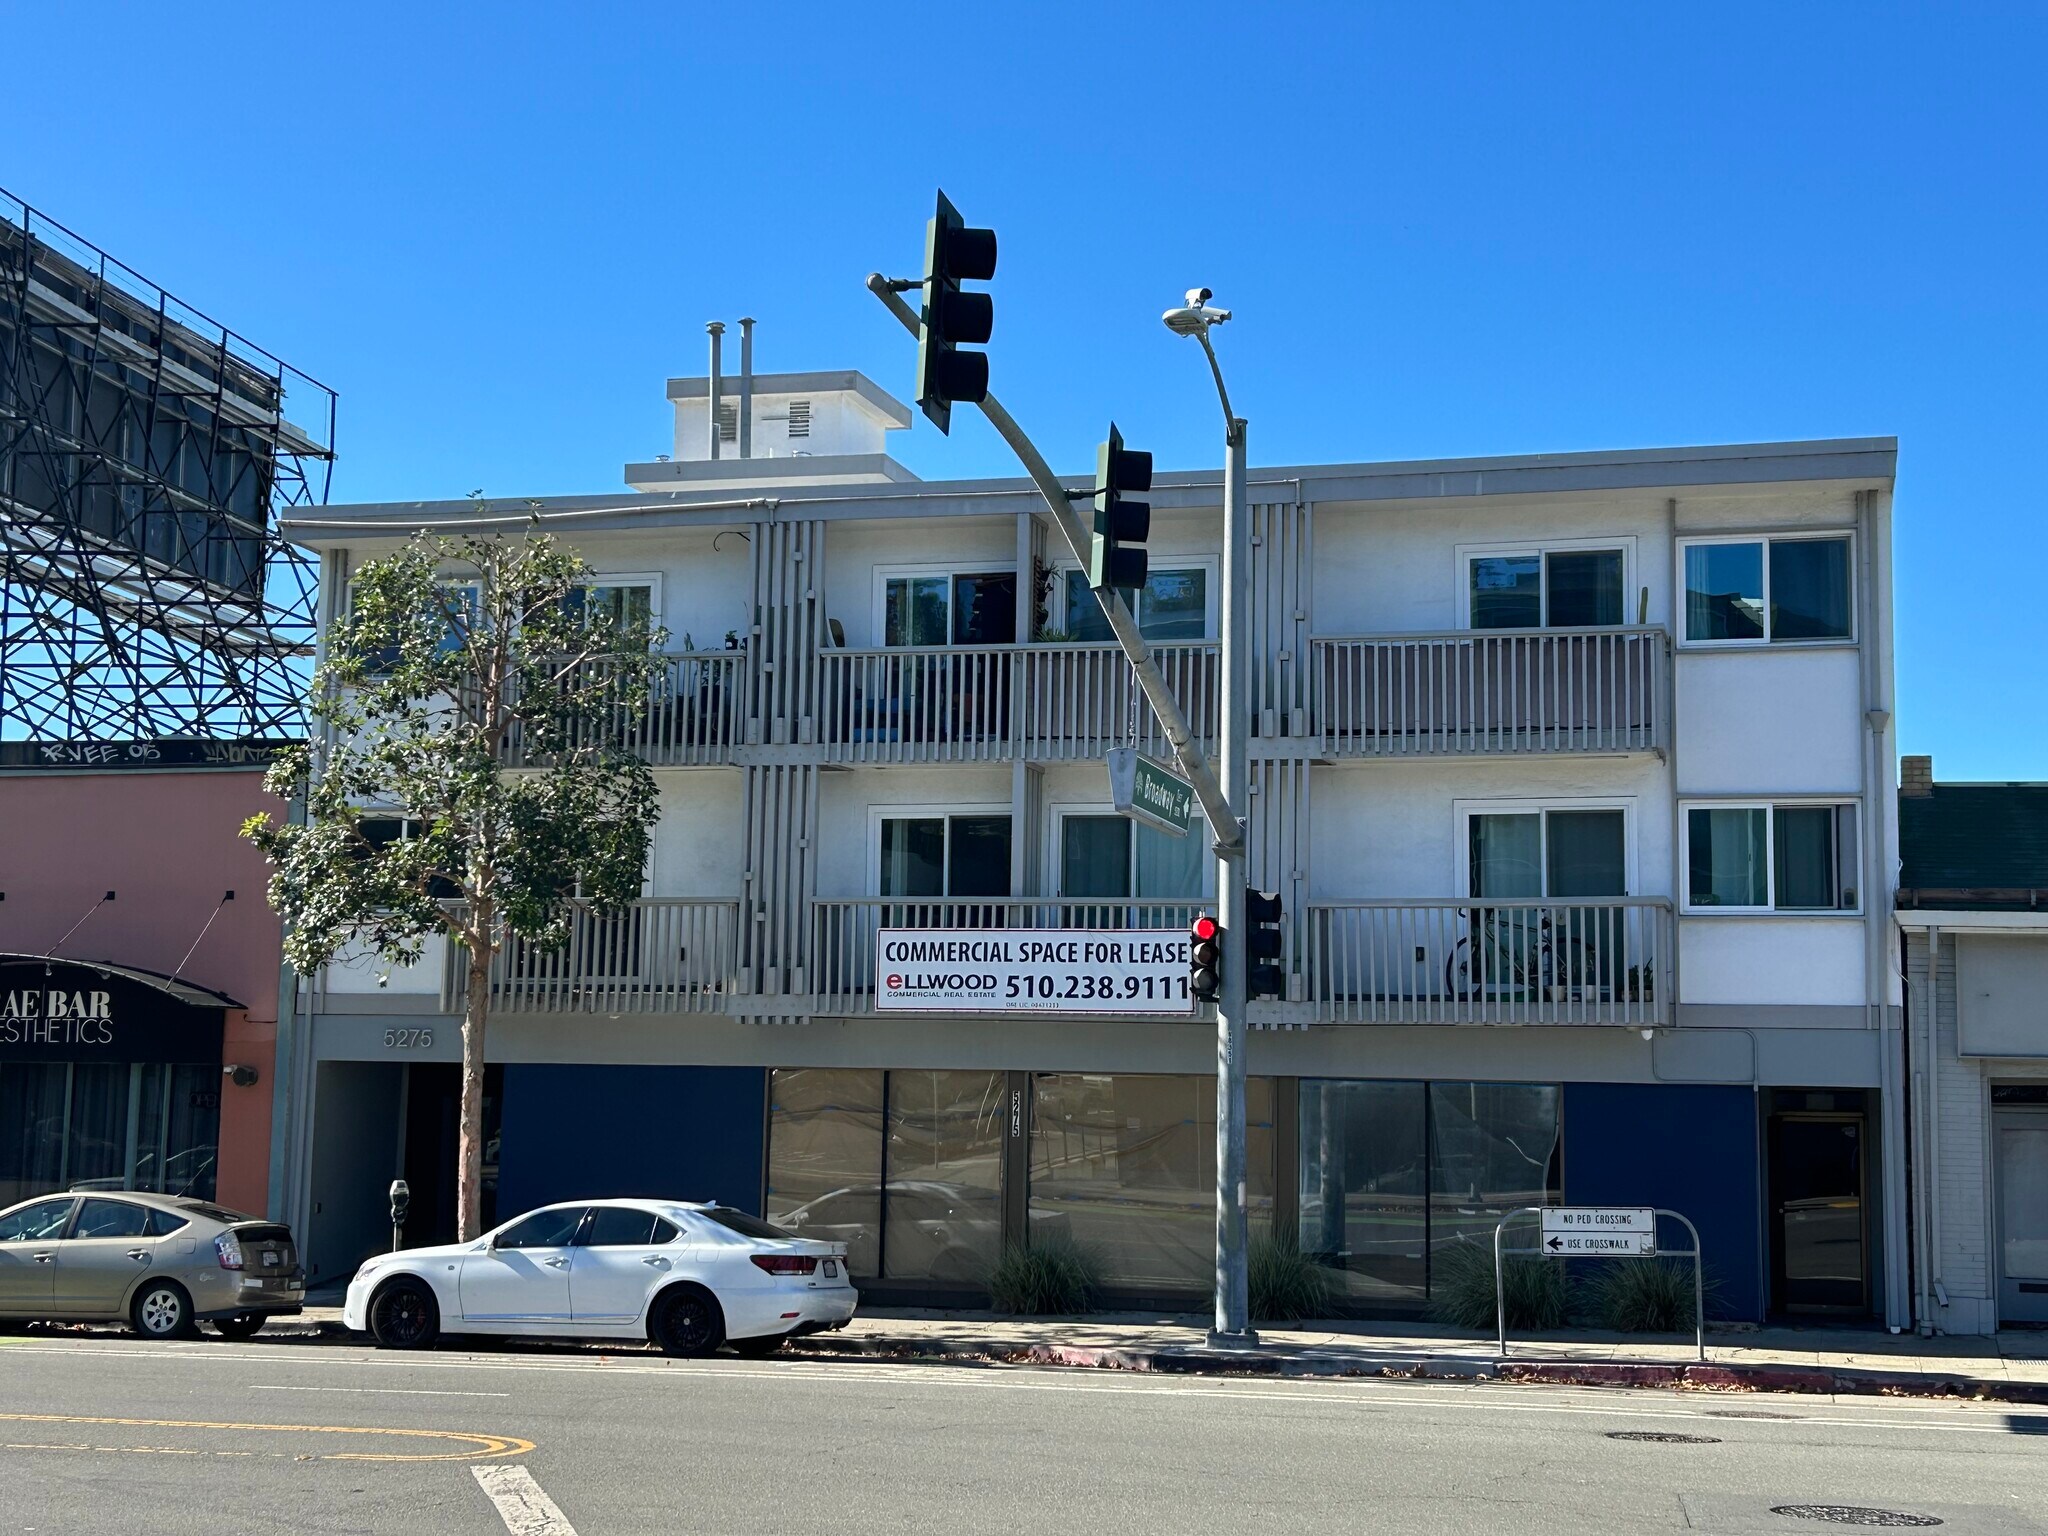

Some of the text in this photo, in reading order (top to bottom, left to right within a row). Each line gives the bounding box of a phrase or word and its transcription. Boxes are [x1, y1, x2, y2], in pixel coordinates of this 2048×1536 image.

[1144, 773, 1176, 818] Broadway
[885, 941, 1188, 964] COMMERCIAL SPACE FOR LEASE
[1005, 974, 1188, 1000] 510.238.9111
[0, 989, 112, 1019] AE BAR
[383, 1029, 432, 1048] 5275
[1563, 1215, 1632, 1225] NO PED CROSSING
[1567, 1239, 1630, 1249] USE CROSSWALK
